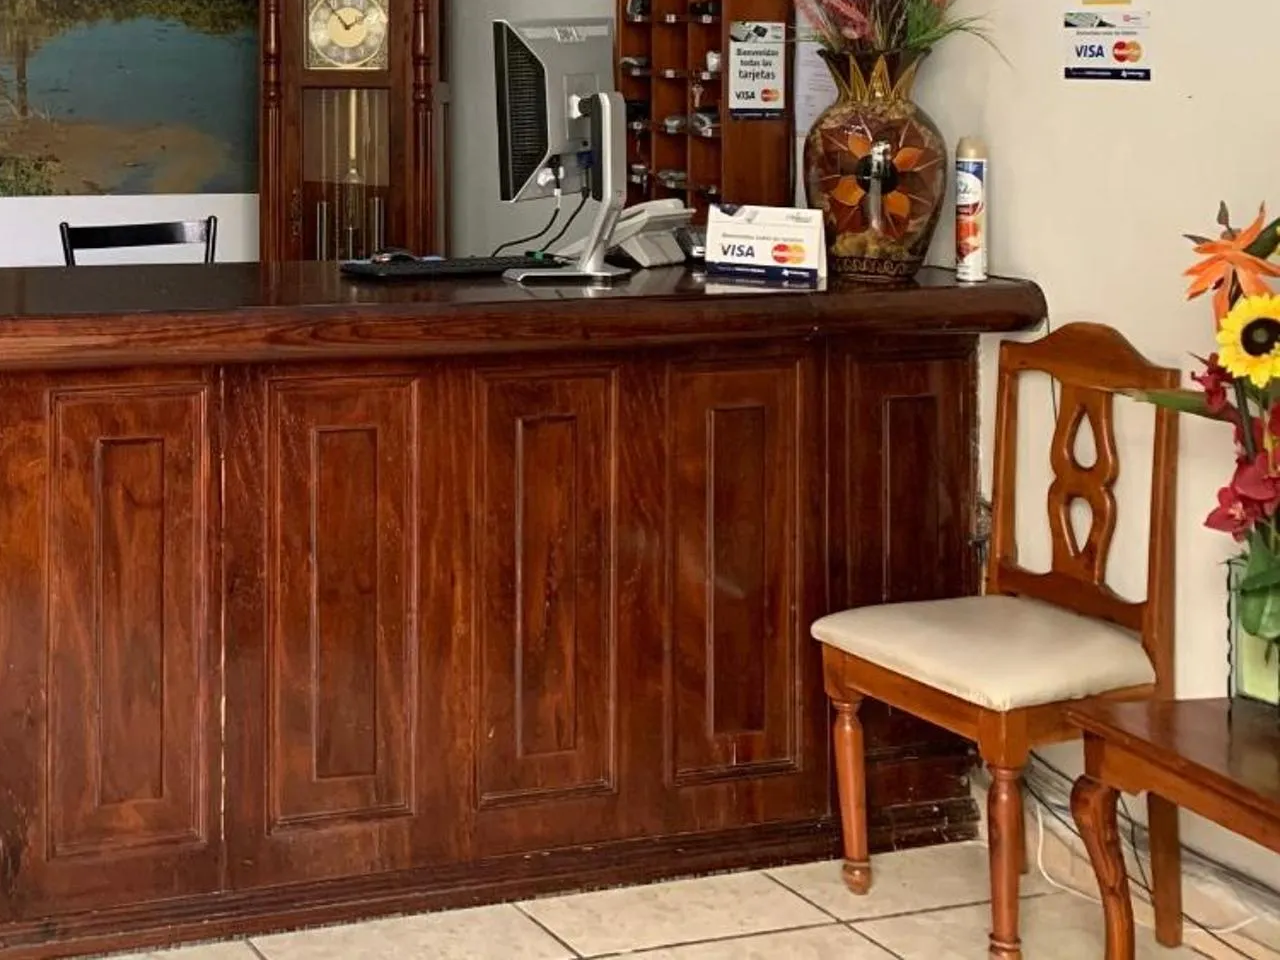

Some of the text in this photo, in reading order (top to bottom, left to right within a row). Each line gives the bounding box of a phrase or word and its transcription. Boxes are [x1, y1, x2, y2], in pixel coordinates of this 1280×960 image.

[1075, 44, 1105, 58] VISA
[738, 70, 776, 81] tarjetas
[735, 91, 756, 100] VISA
[721, 243, 755, 258] VISA
